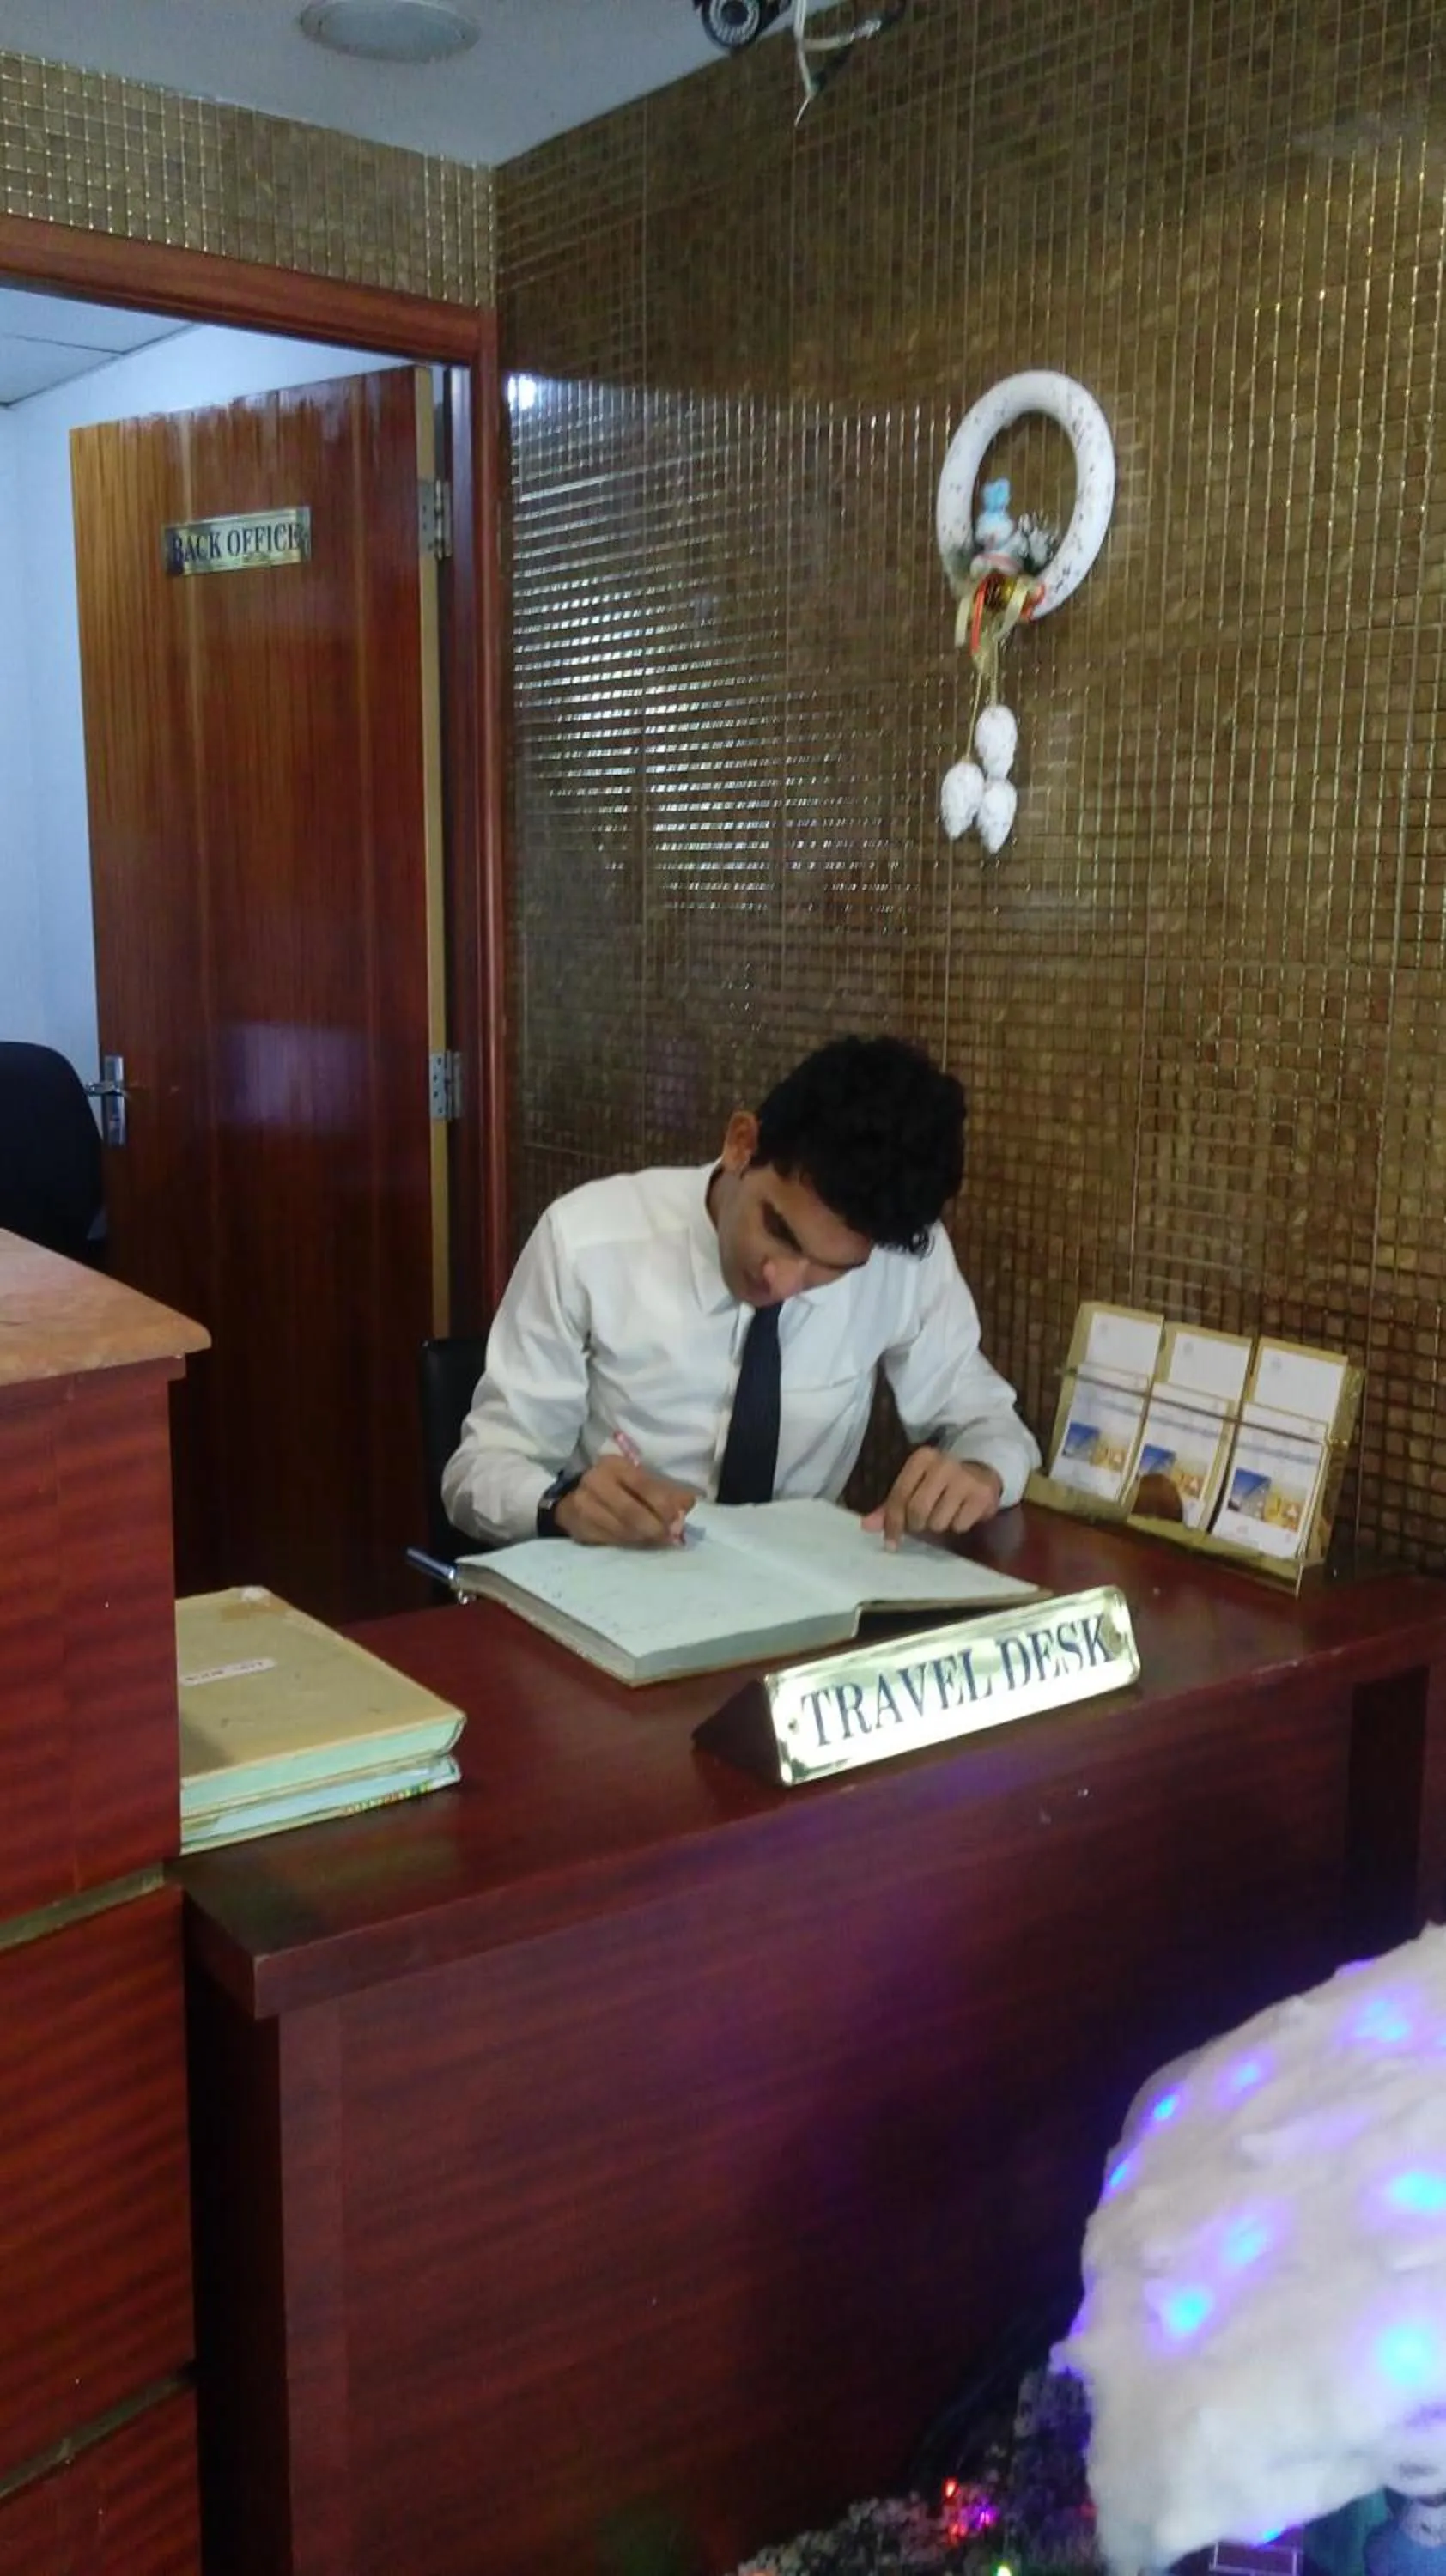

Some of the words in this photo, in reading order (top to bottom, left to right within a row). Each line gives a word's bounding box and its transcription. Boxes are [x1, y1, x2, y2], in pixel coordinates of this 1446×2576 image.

[172, 531, 222, 562] BACK
[227, 522, 302, 557] OFFICE
[801, 1647, 992, 1747] TRAVEL
[994, 1613, 1114, 1692] DESK
